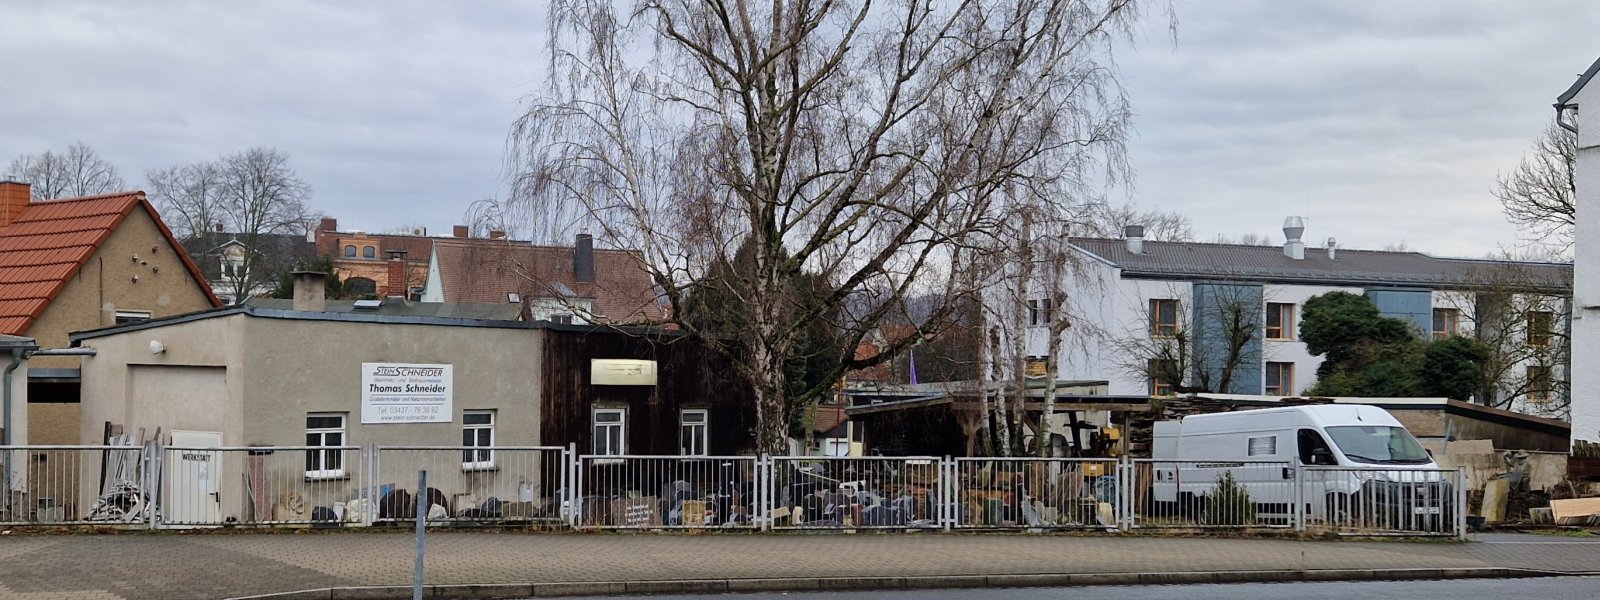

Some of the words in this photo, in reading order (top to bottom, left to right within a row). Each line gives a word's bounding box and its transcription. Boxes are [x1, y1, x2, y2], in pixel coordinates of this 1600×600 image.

[369, 383, 402, 392] Thomas
[405, 383, 446, 393] Schneider
[390, 406, 408, 414] 03437
[182, 453, 211, 462] WERKSTATT
